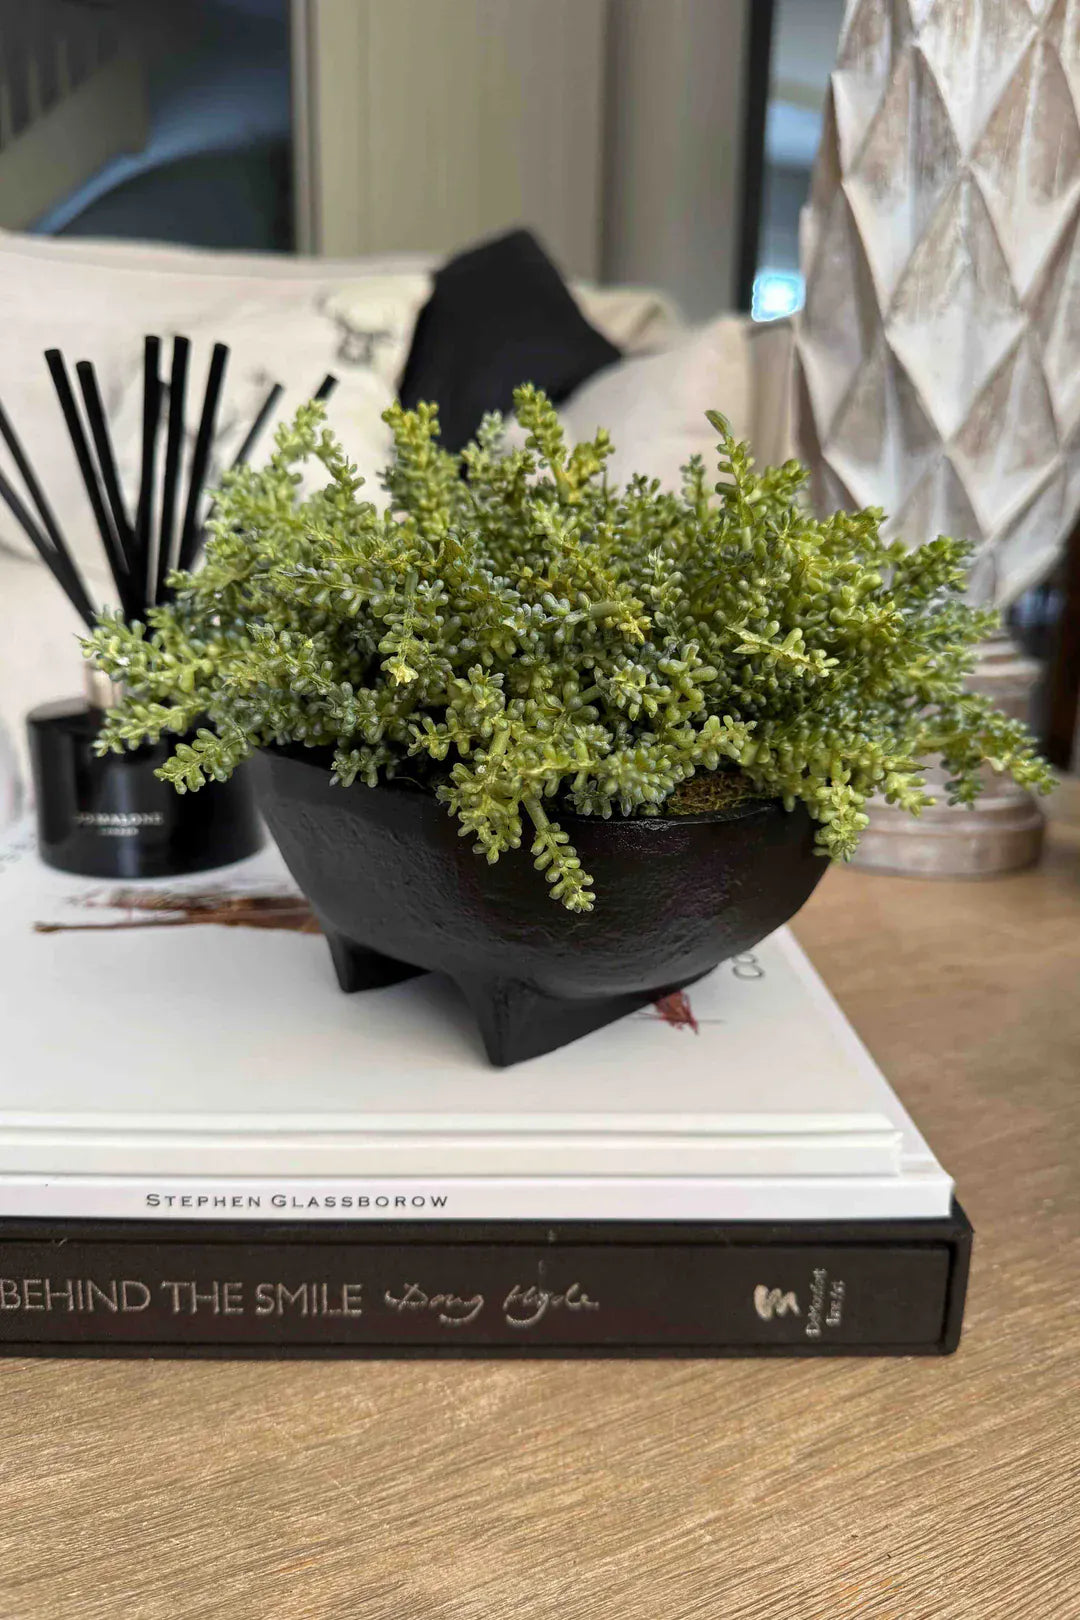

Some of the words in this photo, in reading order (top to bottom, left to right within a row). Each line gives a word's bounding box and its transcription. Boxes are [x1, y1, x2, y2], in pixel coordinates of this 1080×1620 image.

[146, 1194, 261, 1207] STEPHEN
[271, 1194, 449, 1207] GLASSBOROW
[0, 1279, 151, 1313] BEHIND
[161, 1281, 244, 1314] THE
[255, 1282, 363, 1316] SMILE
